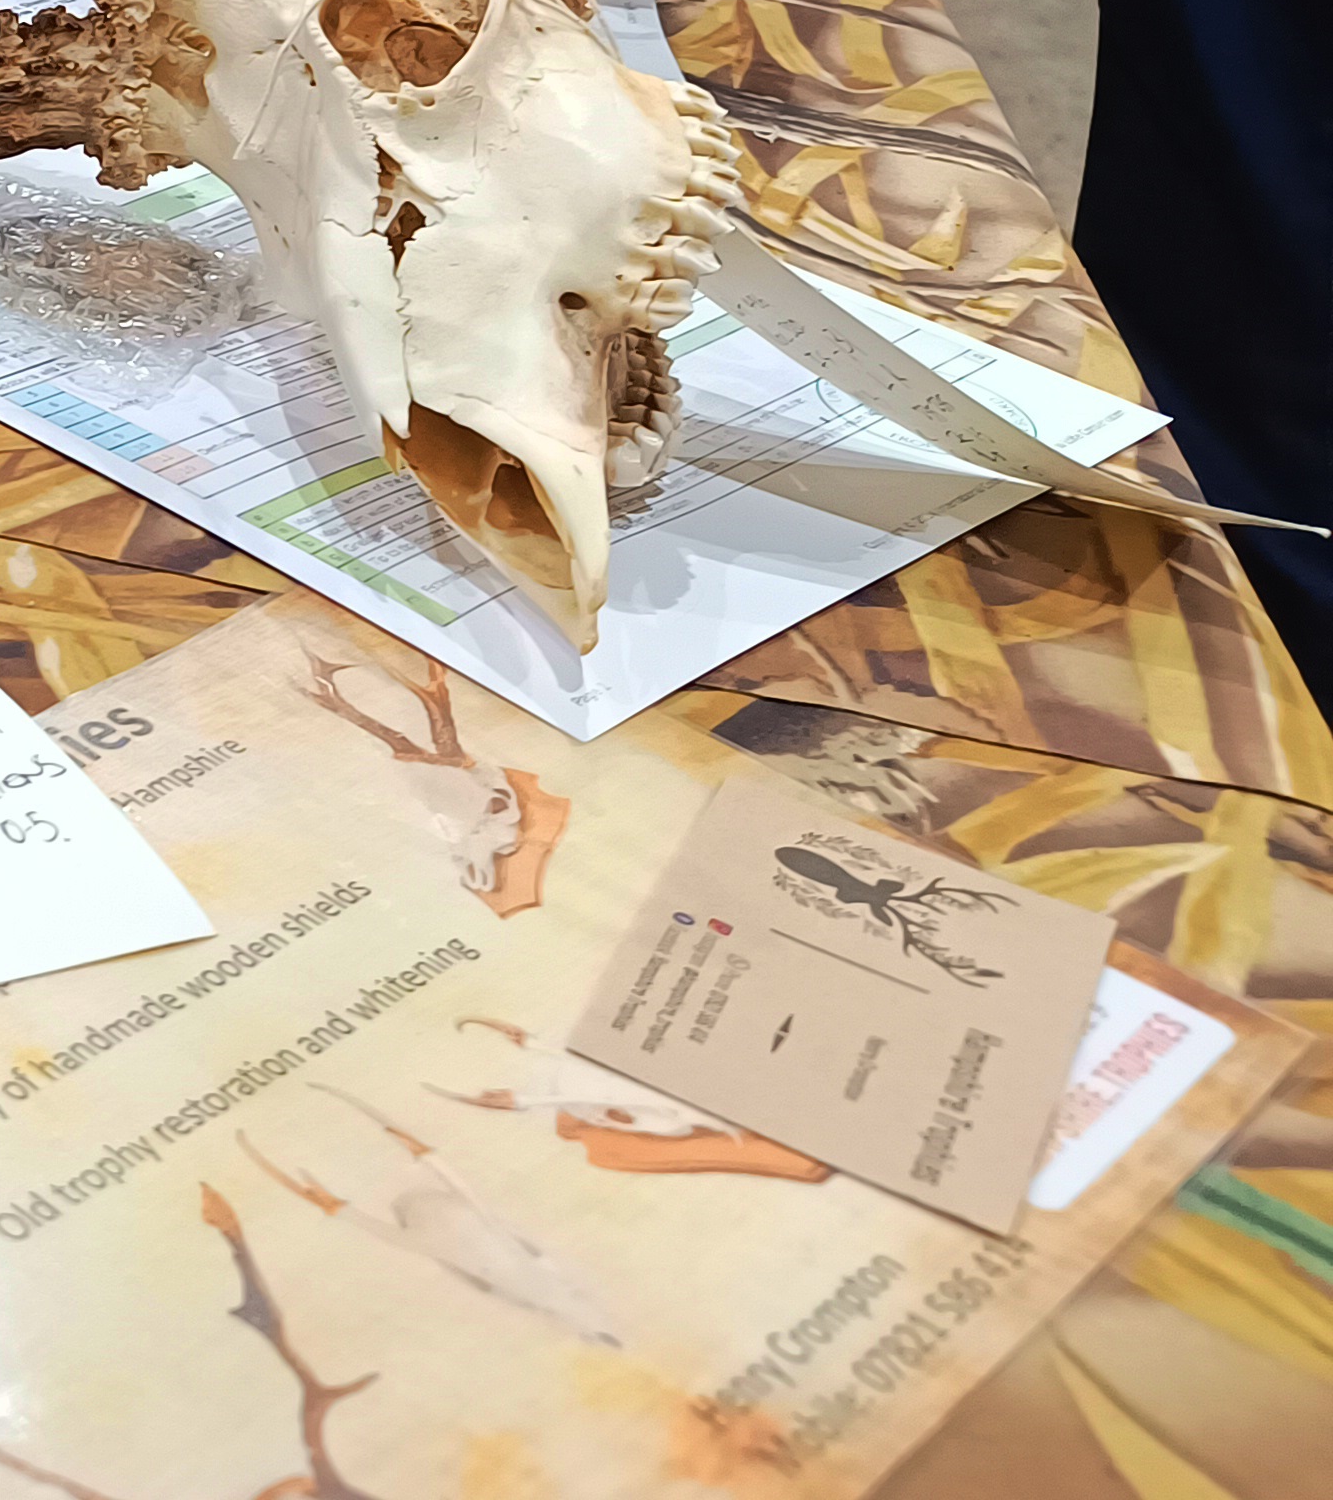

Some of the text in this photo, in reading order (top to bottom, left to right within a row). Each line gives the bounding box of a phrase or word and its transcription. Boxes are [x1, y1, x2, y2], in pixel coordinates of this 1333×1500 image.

[113, 737, 247, 813] Hampshire
[2, 1066, 36, 1102] of
[27, 987, 184, 1082] handmade
[177, 926, 291, 1003] wooden
[280, 874, 373, 940] shields
[51, 1137, 165, 1205] trophy
[149, 1044, 307, 1142] restoration
[296, 1011, 357, 1057] and
[344, 936, 482, 1022] whitening
[765, 1251, 908, 1369] Crompton
